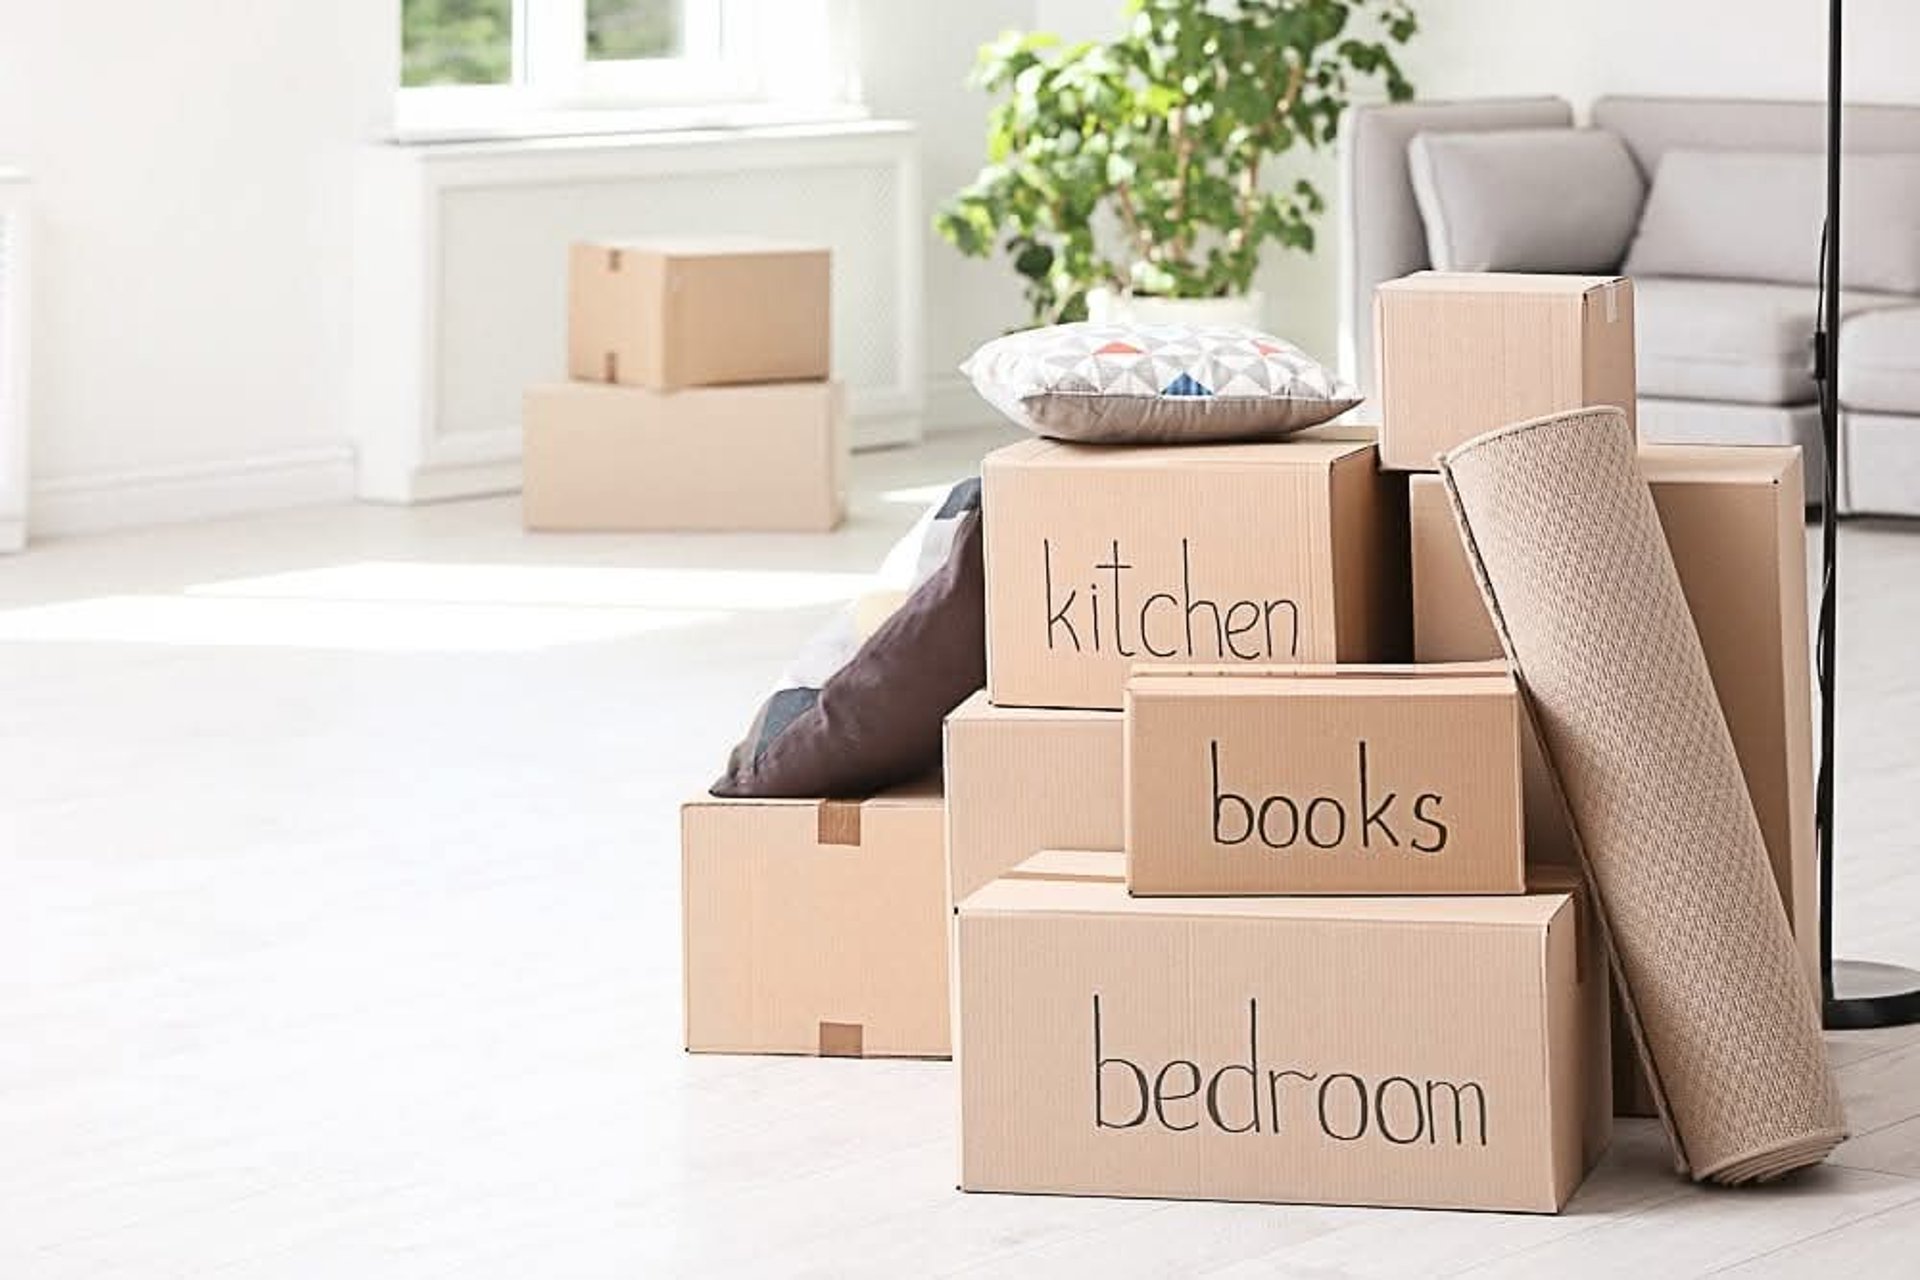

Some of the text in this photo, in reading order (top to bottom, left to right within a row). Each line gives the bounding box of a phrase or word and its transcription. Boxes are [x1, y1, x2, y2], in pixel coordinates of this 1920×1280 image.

[1044, 537, 1298, 660] kitchen
[1210, 740, 1448, 853] books
[1093, 994, 1487, 1146] bedroom
